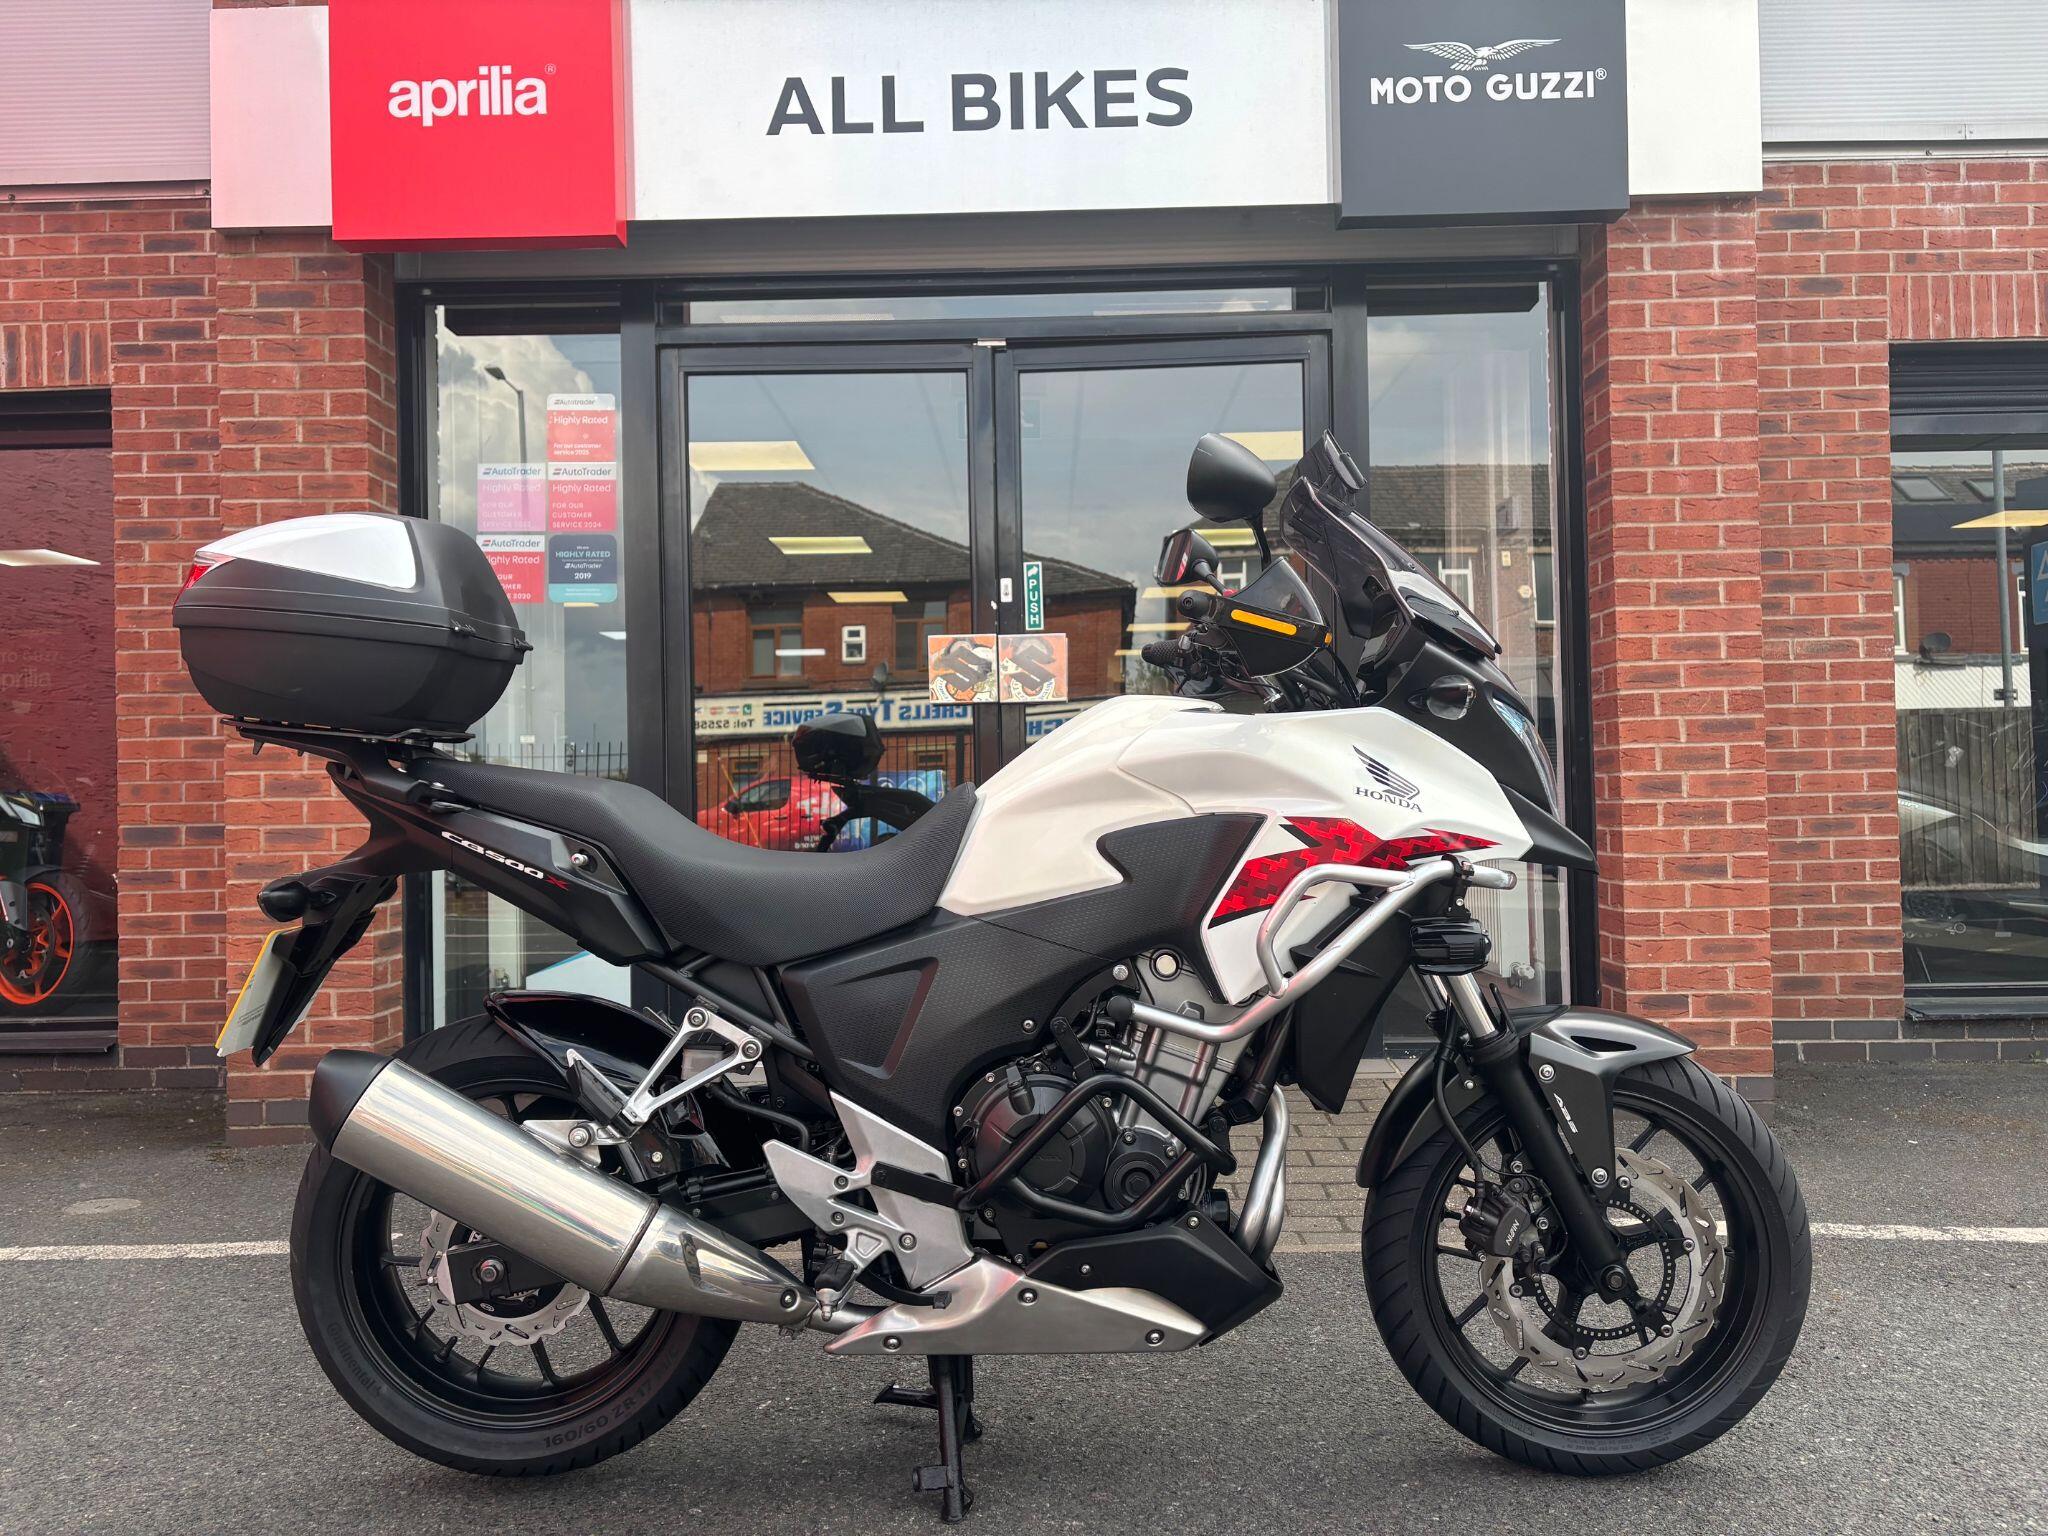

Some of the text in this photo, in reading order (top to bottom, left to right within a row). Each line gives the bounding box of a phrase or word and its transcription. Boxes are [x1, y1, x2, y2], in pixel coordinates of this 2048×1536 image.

[1370, 75, 1472, 105] MOTO
[766, 67, 1193, 136] ALL BIKES
[553, 416, 608, 426] Highly Rated
[491, 467, 541, 476] AutoTrader
[561, 467, 611, 476] AutoTrader
[552, 483, 611, 495] Highly Rated
[552, 511, 592, 519] CUSTOMER
[552, 521, 582, 529] SERVICE
[490, 539, 541, 548] AutoTrader
[585, 550, 611, 558] RATED
[488, 554, 540, 566] ighly Rated
[574, 572, 592, 580] 2019
[1028, 579, 1040, 625] PUSH
[1355, 786, 1423, 813] HONDA
[1553, 1092, 1579, 1134] ABS
[543, 1415, 609, 1449] 160/60
[611, 1396, 637, 1419] ZR
